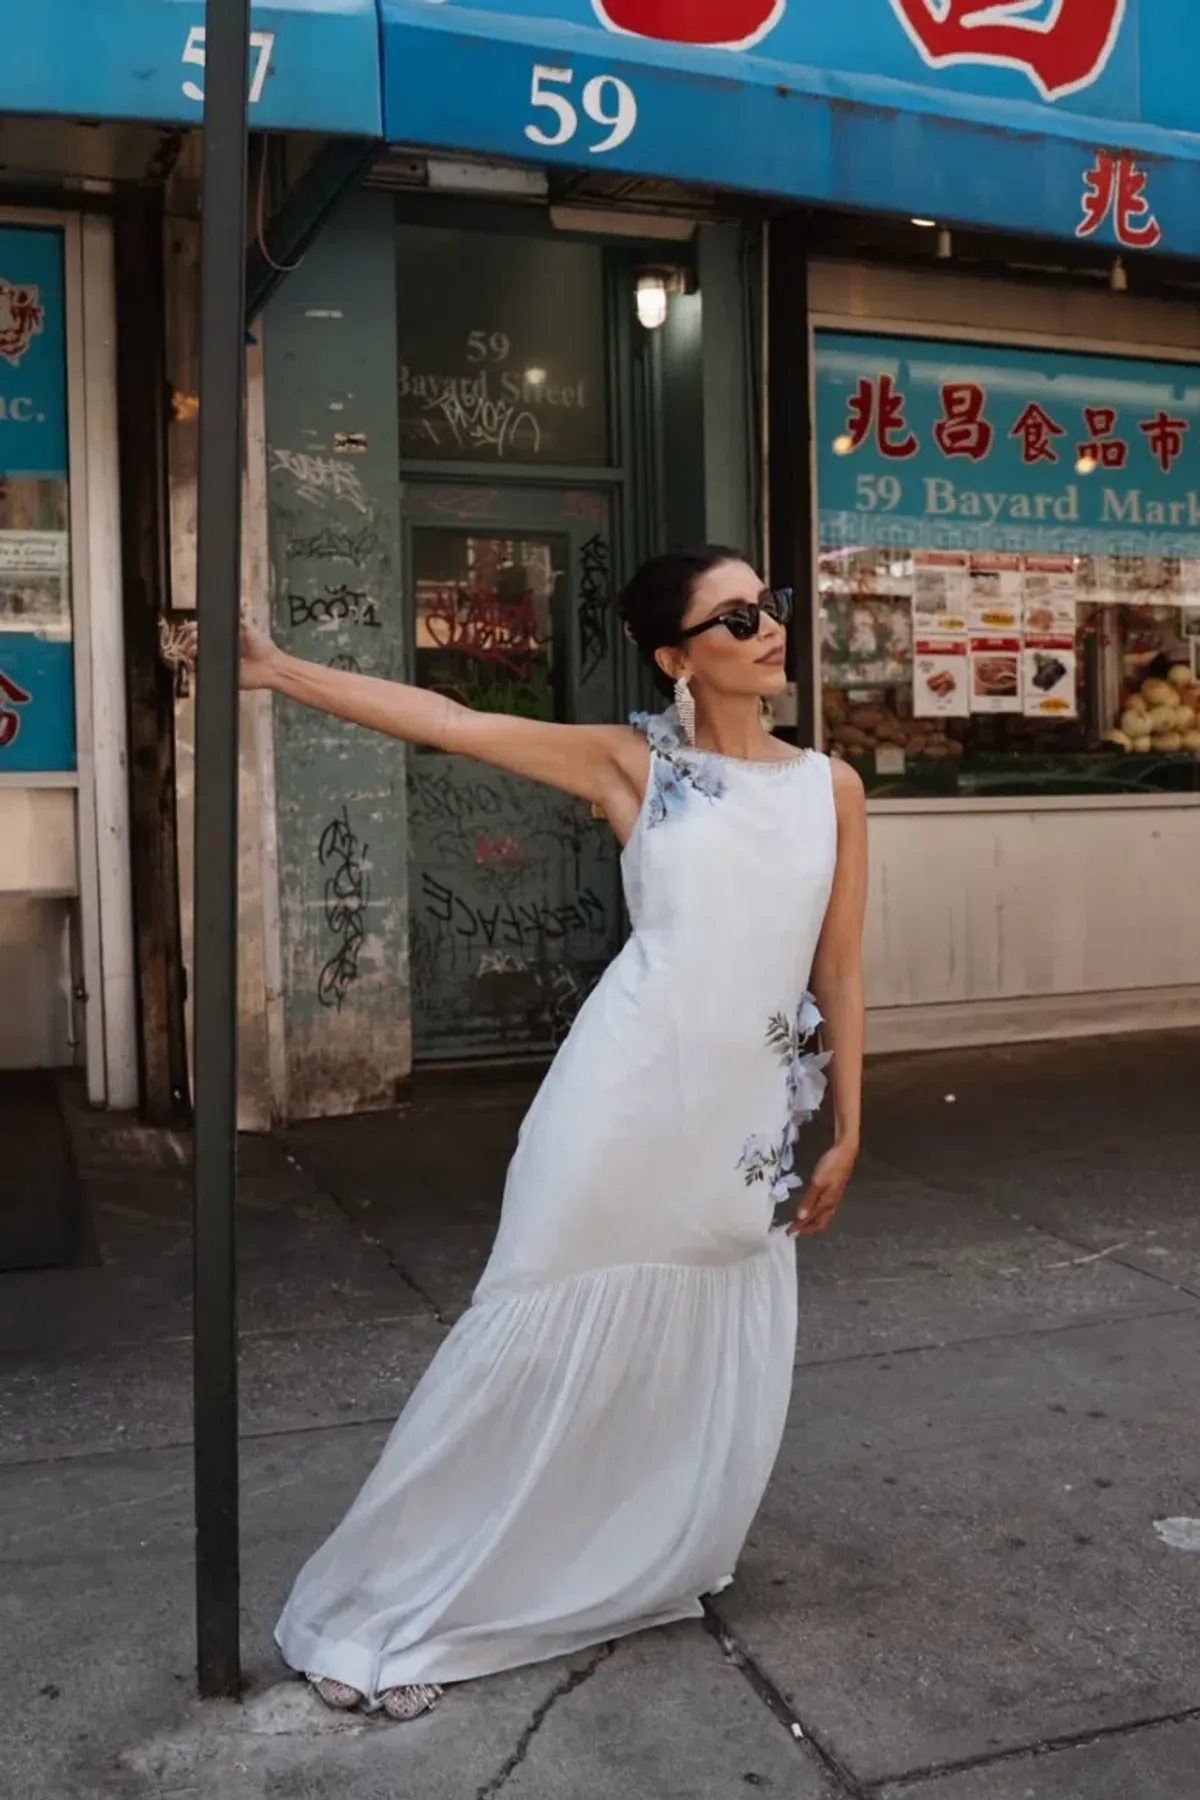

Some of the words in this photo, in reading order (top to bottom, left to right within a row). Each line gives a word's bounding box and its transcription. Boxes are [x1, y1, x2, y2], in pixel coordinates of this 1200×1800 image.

[524, 64, 637, 152] 59
[1075, 148, 1161, 249] 兆
[466, 329, 511, 363] 59
[855, 473, 902, 512] 59
[922, 477, 1079, 527] Bayard
[421, 871, 606, 947] NECKFACE
